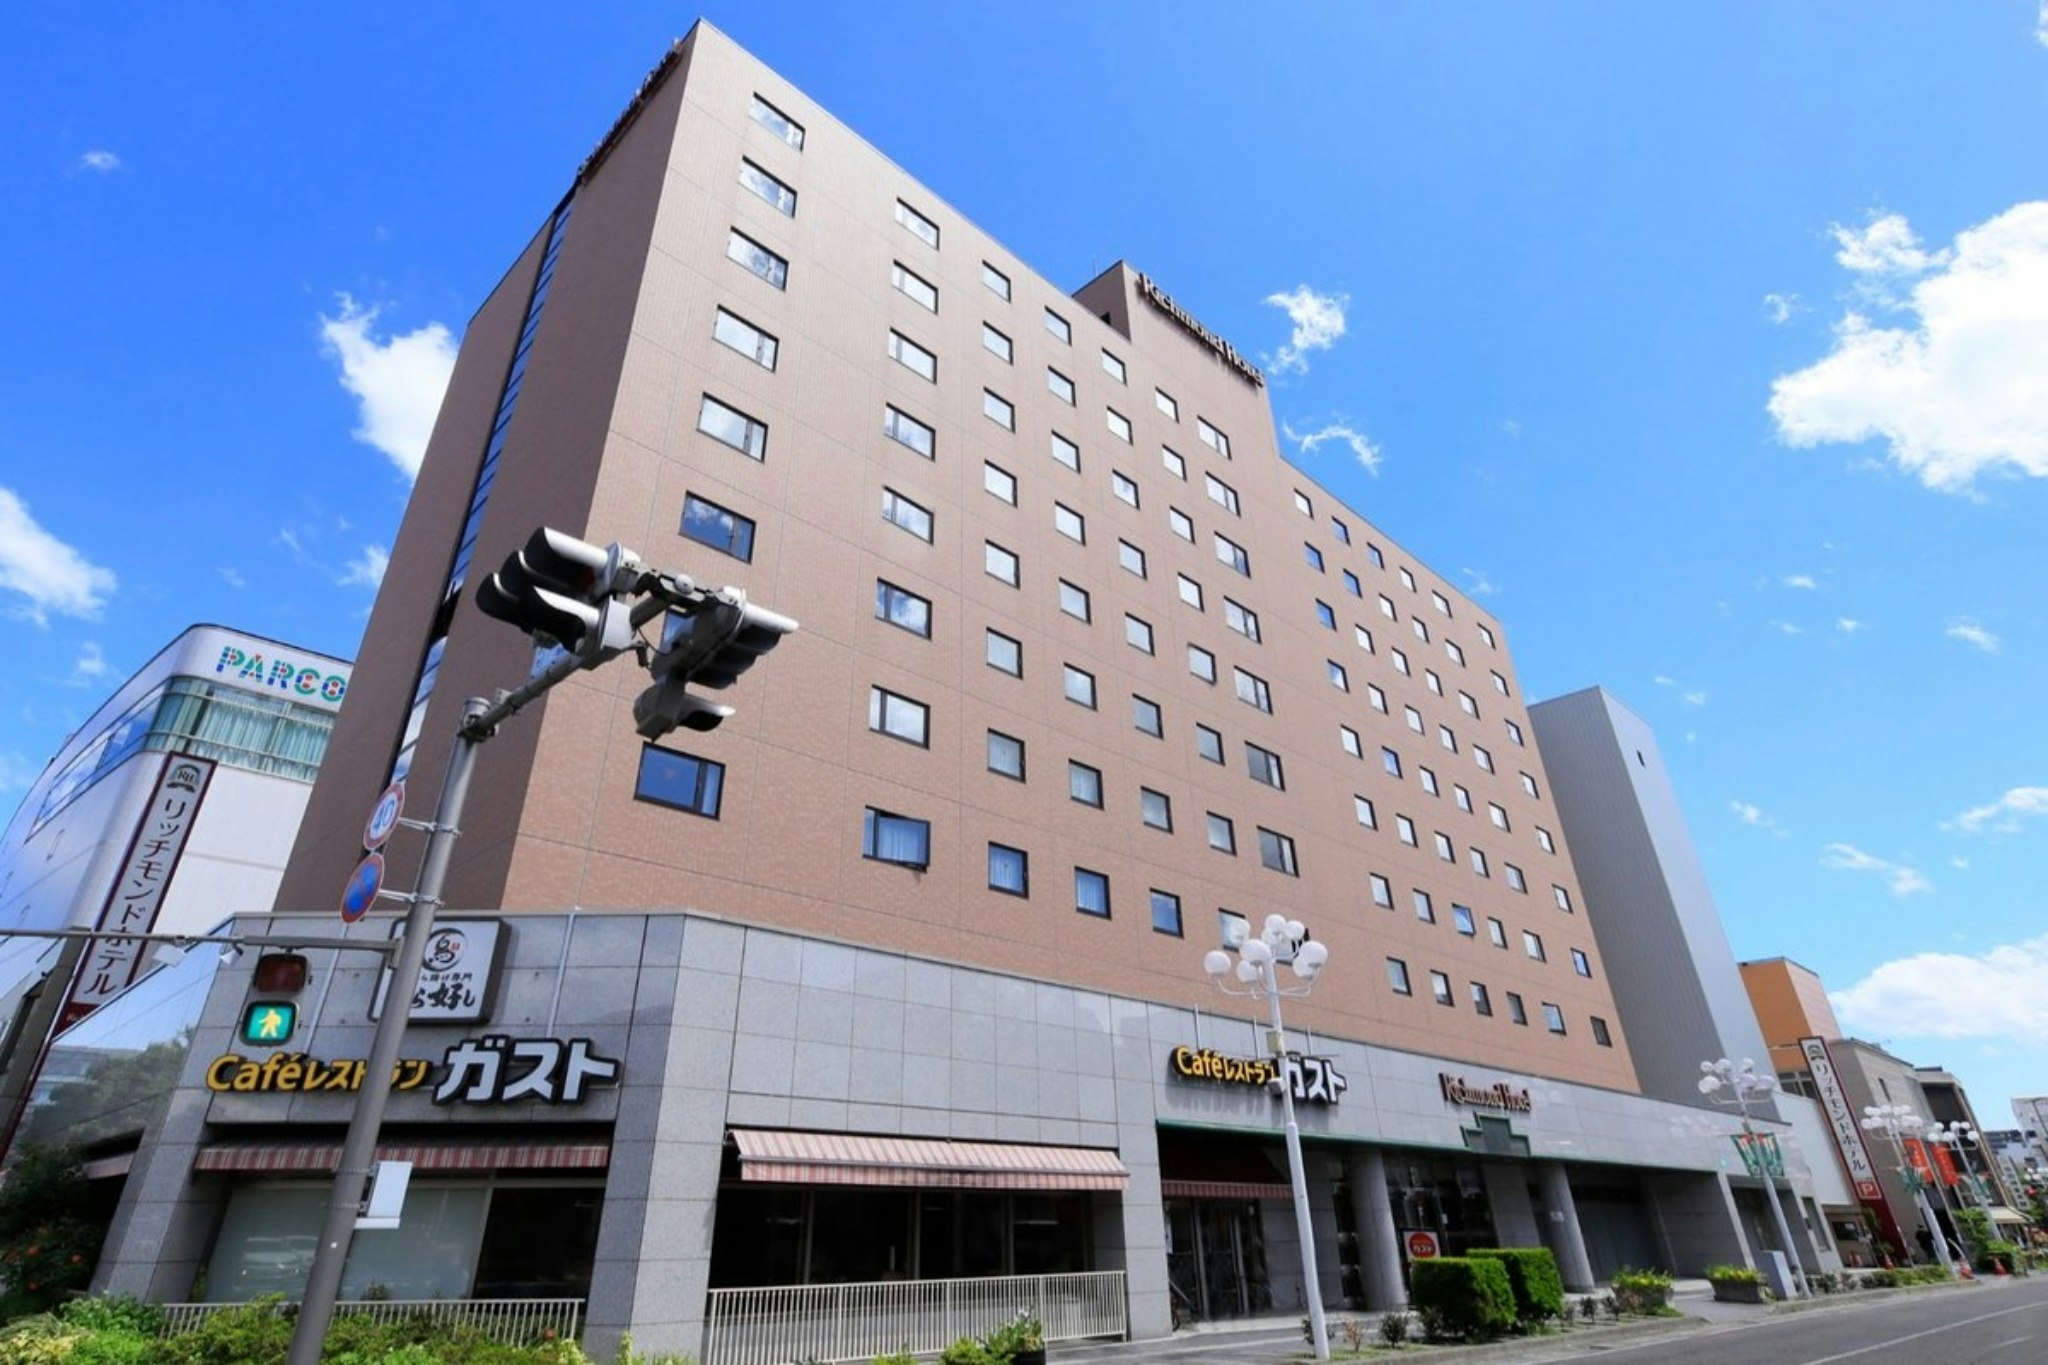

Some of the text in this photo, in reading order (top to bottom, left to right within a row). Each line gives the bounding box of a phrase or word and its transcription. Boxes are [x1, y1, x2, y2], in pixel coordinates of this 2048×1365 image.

[216, 646, 346, 702] PARCO
[373, 799, 396, 830] 40
[84, 798, 187, 996] リッチモンドホテル
[411, 982, 476, 1011] ら好し
[434, 1036, 619, 1102] ガスト
[1816, 1063, 1867, 1171] リッチモンドホテル
[1861, 1183, 1874, 1196] P
